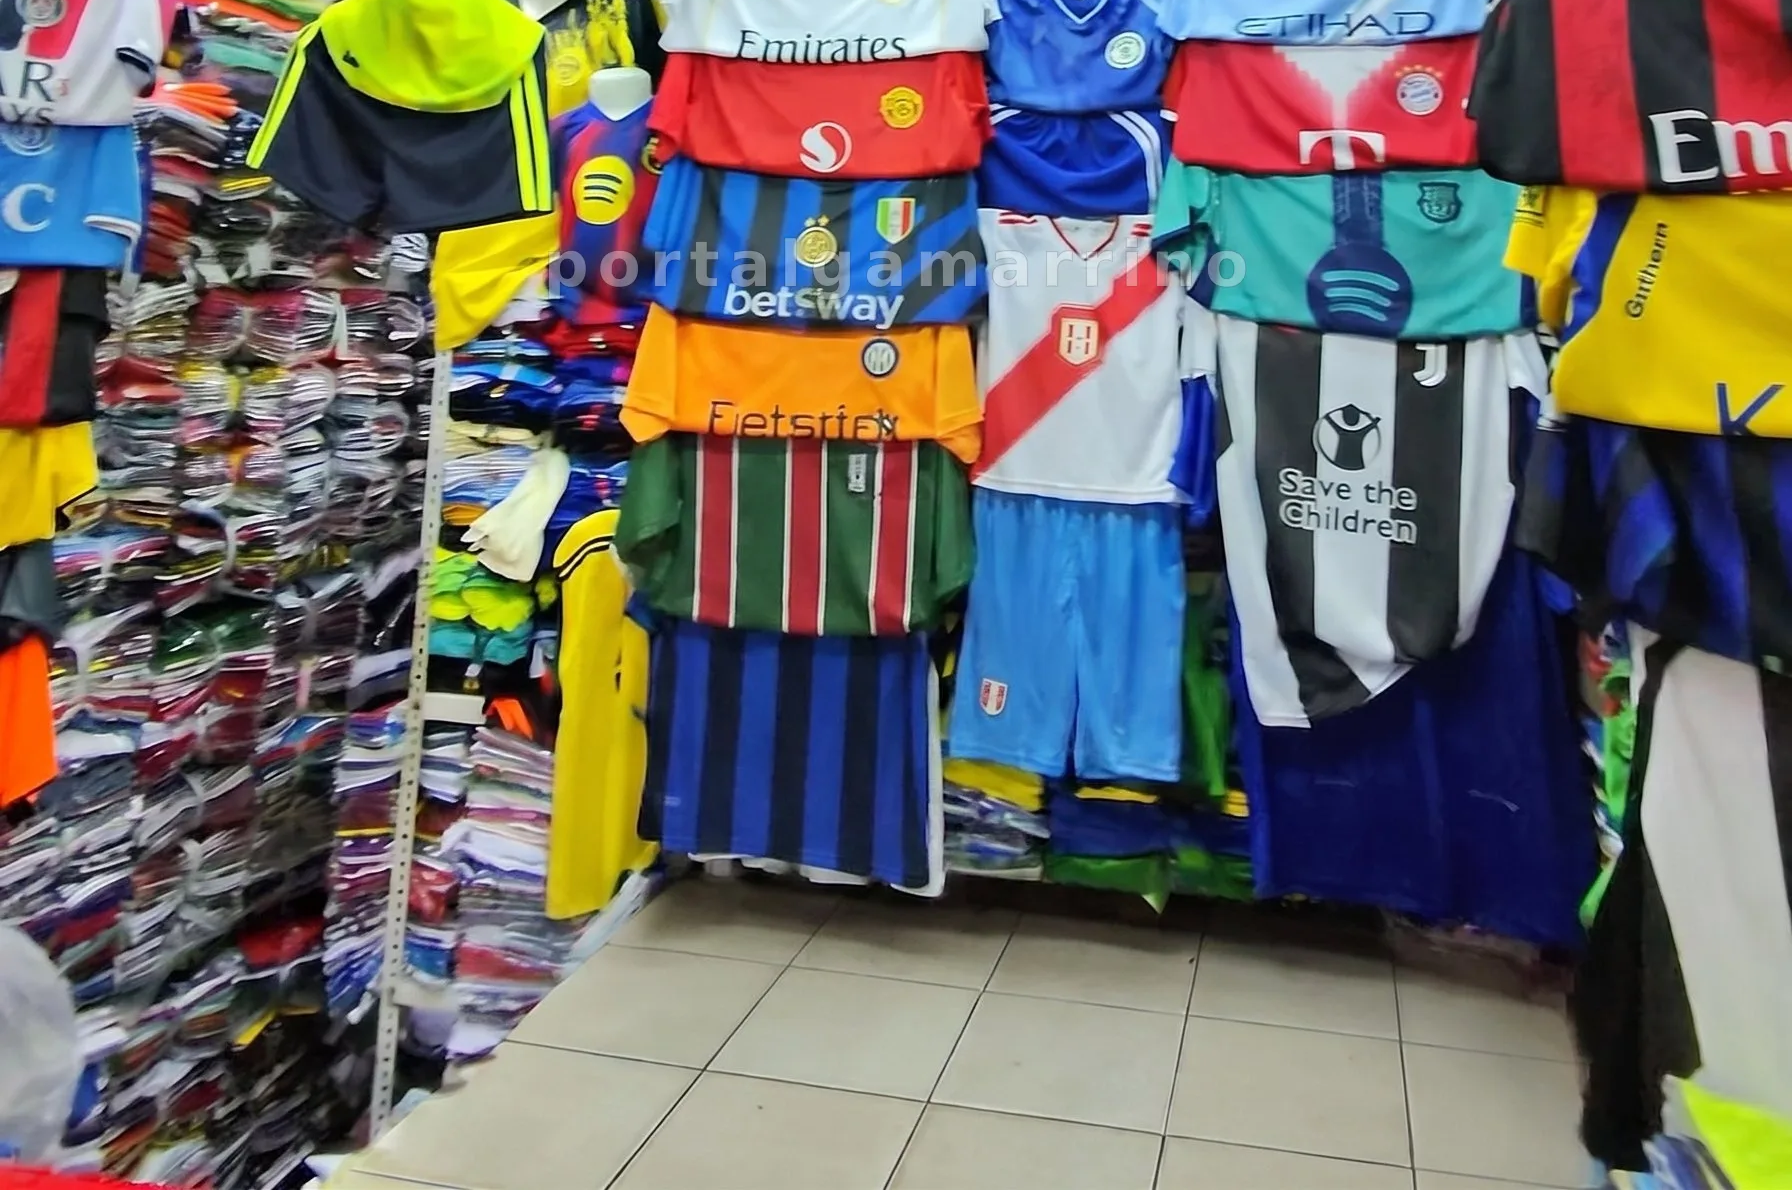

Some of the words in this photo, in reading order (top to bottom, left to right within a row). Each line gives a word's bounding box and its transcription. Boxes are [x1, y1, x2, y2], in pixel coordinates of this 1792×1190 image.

[1235, 10, 1435, 37] ETIHAD
[736, 29, 907, 64] Emirates
[723, 282, 905, 330] betsway
[1278, 468, 1353, 500] Save
[1363, 479, 1418, 511] the
[1279, 501, 1418, 545] Children
